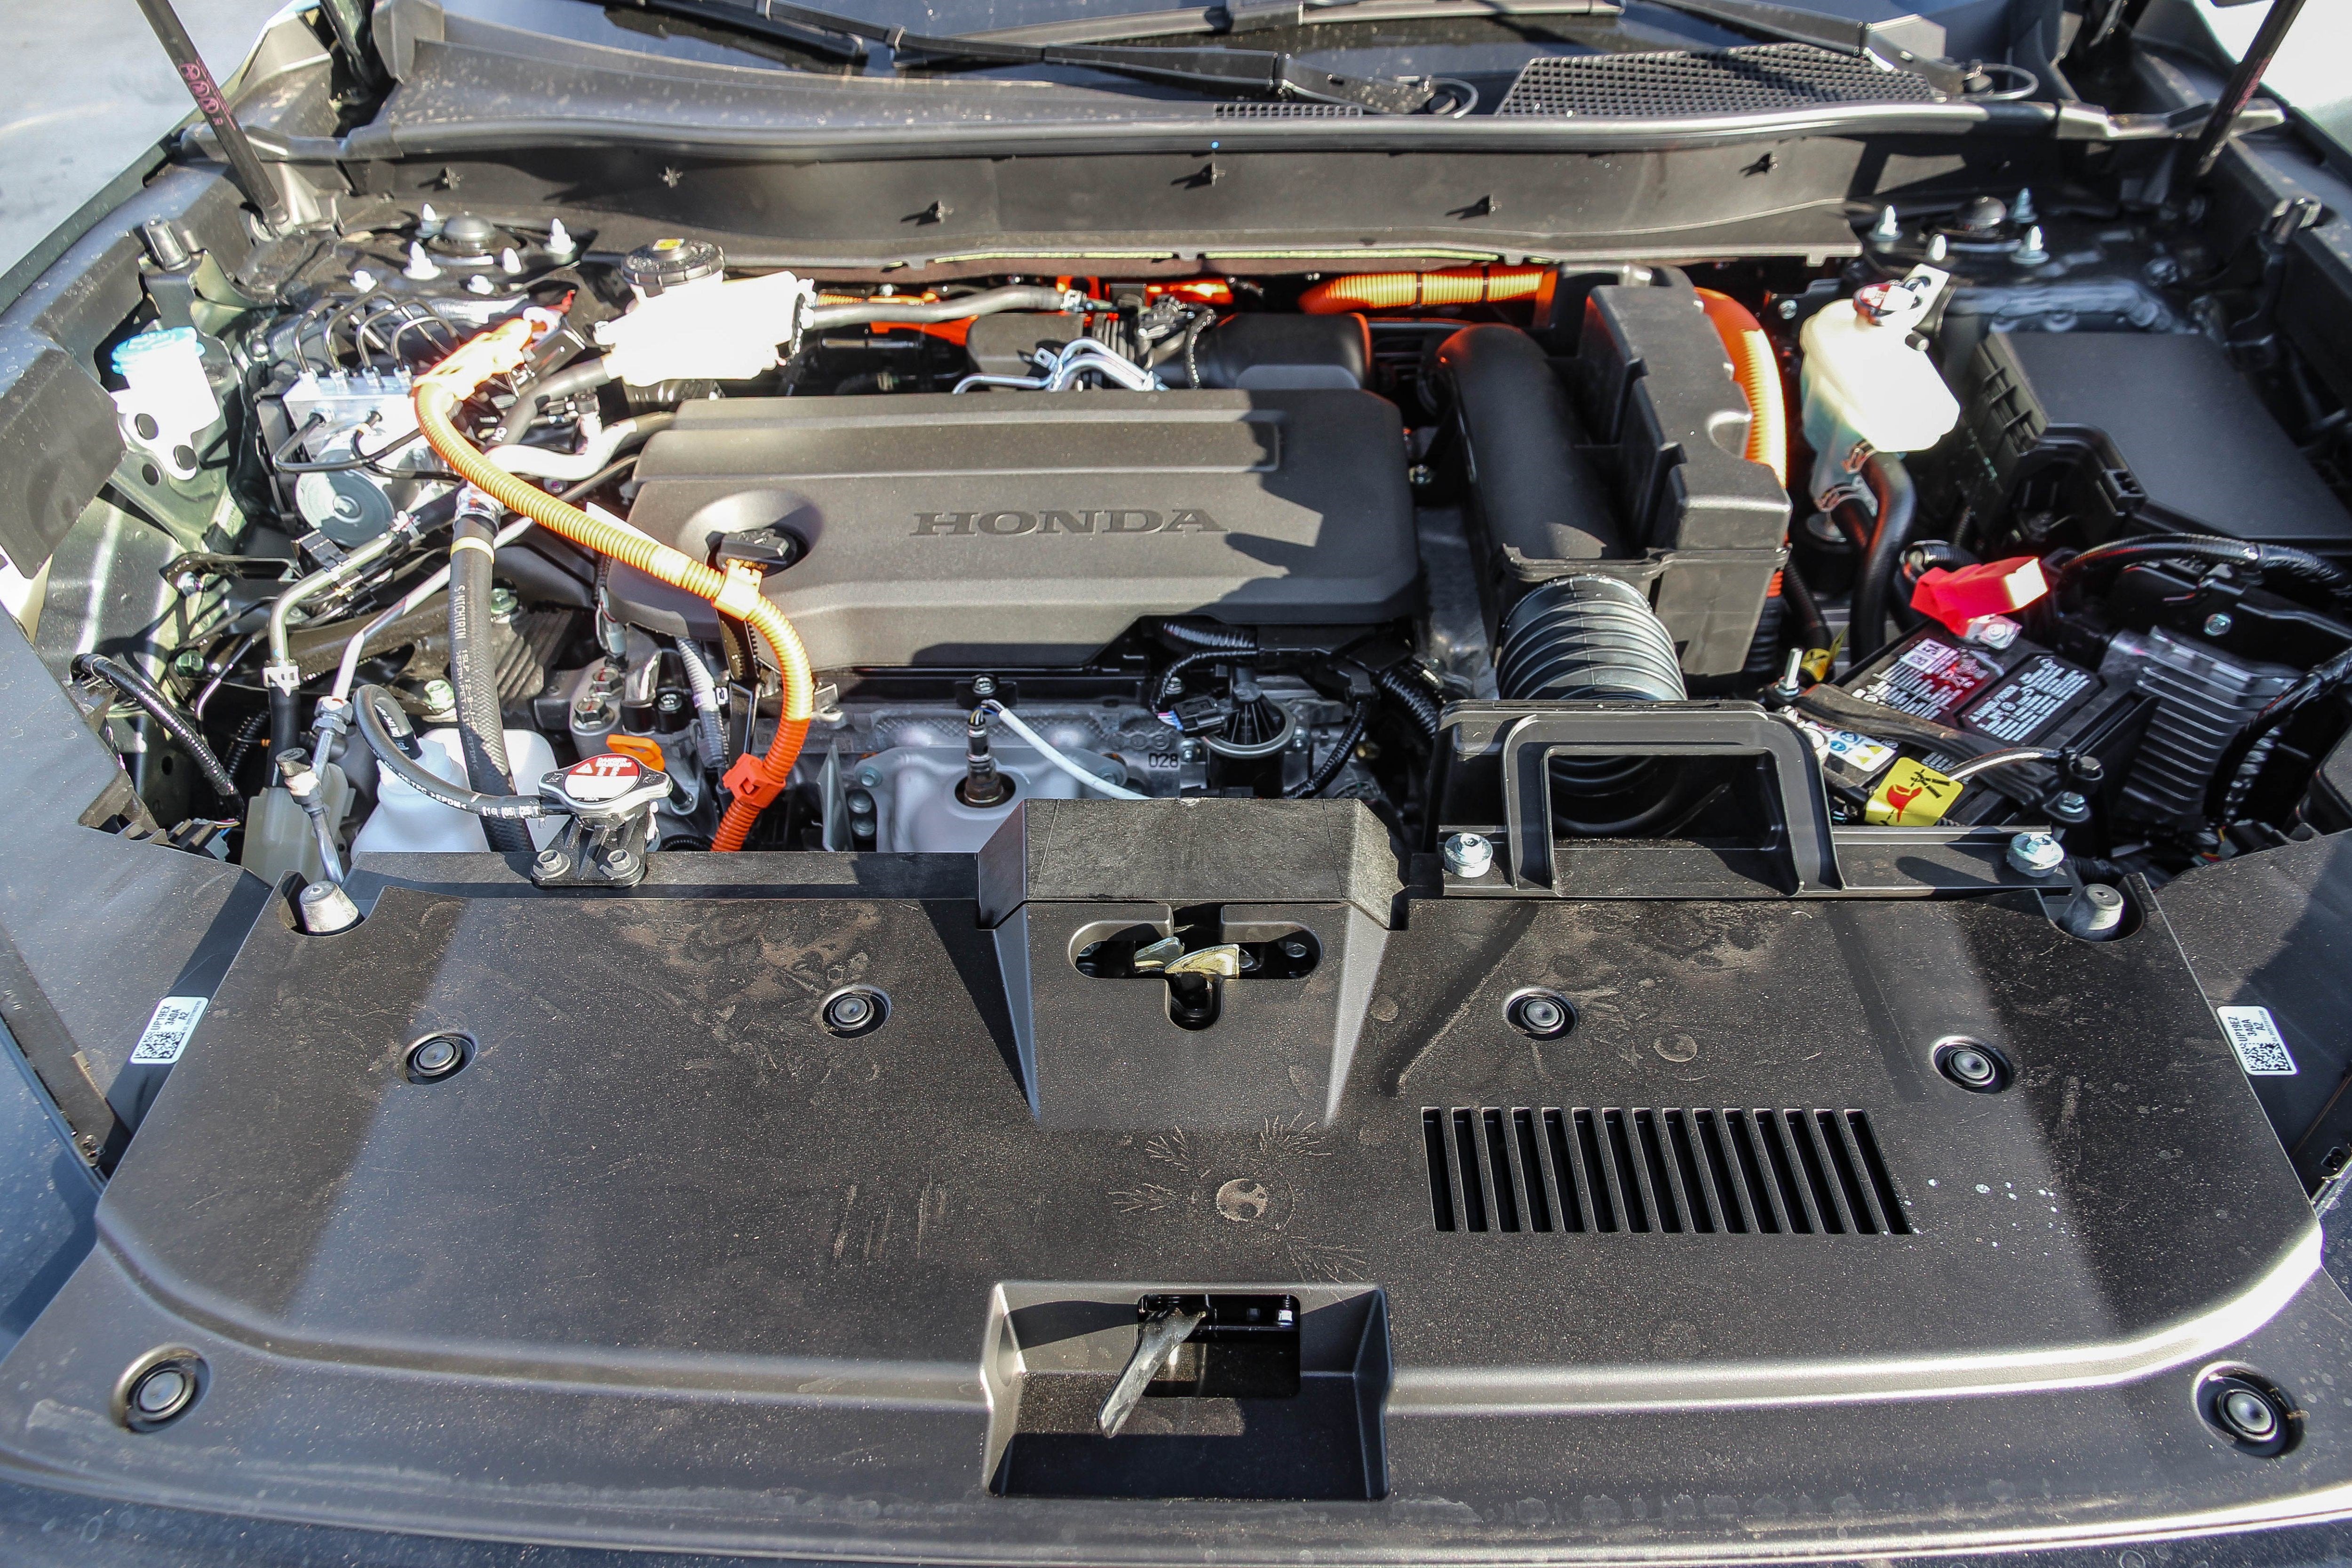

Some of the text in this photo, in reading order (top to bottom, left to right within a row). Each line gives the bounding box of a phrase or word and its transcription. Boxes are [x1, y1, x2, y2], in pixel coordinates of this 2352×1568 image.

[910, 509, 1229, 536] HONDA
[151, 1006, 172, 1030] UP19EX
[2228, 1017, 2248, 1041] UP19EZ
